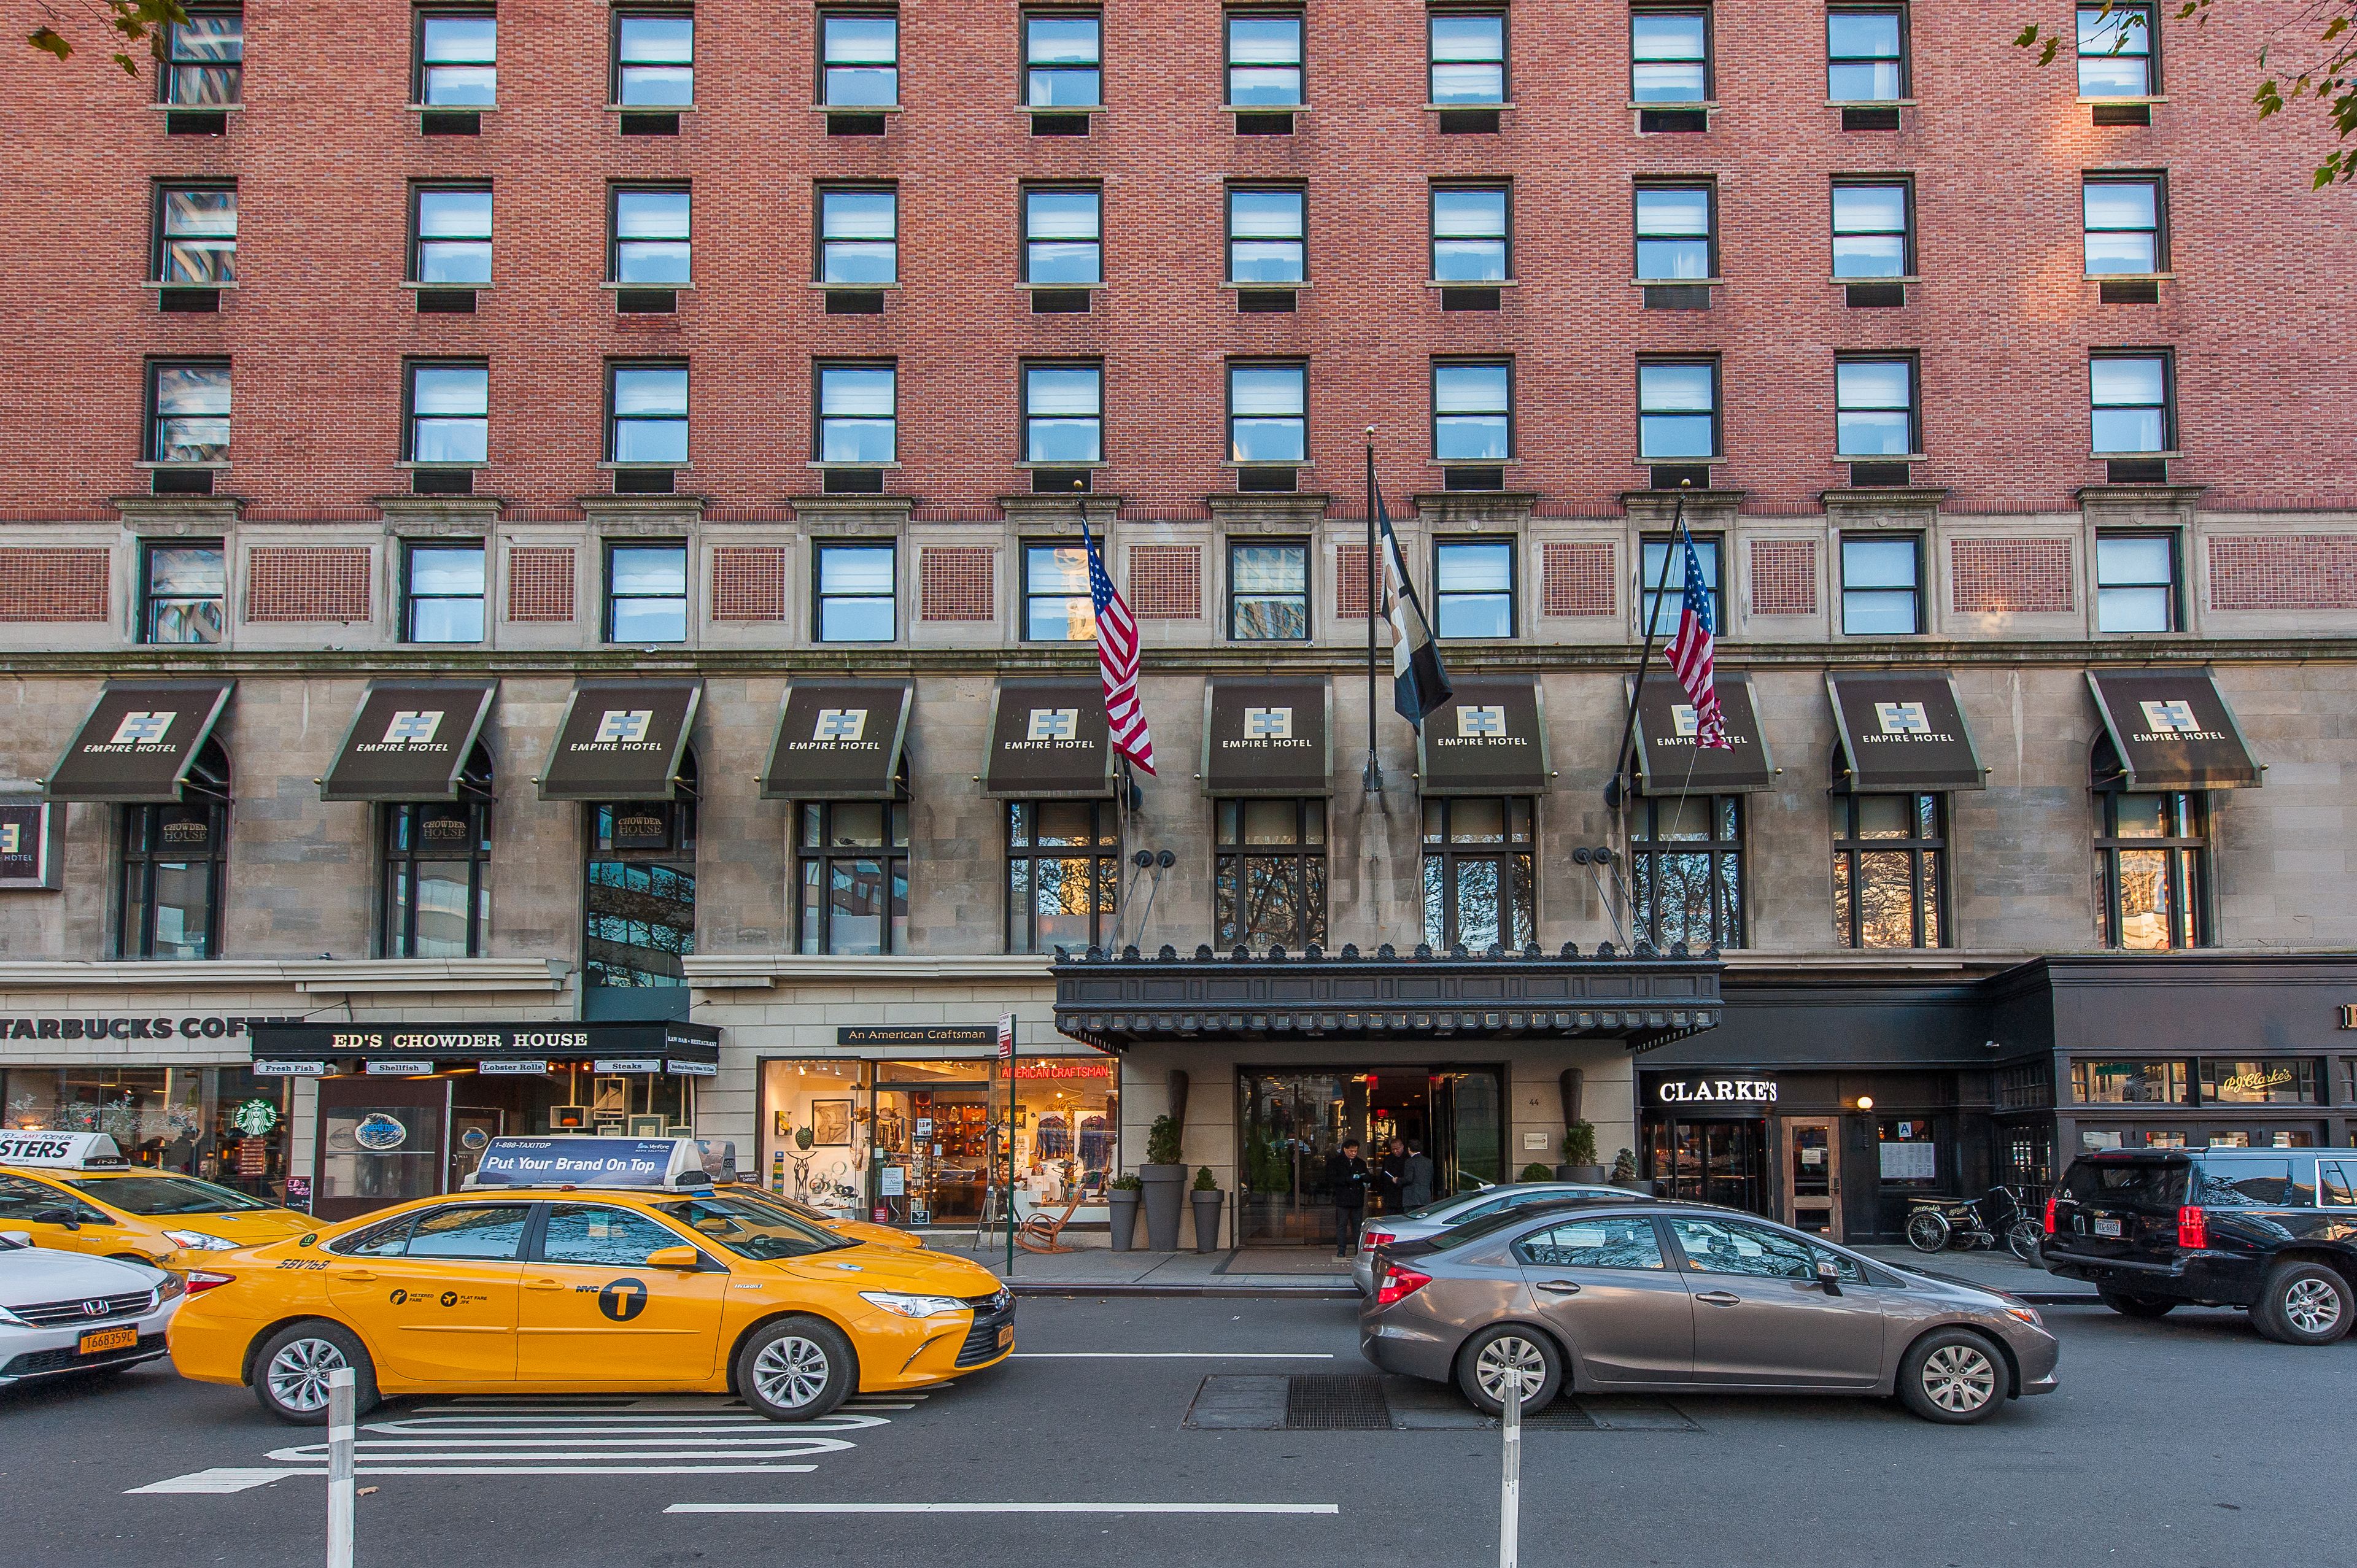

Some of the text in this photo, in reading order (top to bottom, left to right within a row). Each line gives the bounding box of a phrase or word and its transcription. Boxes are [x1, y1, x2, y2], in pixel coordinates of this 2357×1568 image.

[1914, 733, 1954, 742] HOTEL
[2184, 732, 2225, 741] HOTEL
[1055, 740, 1094, 749] HOTEL
[1273, 739, 1312, 747] HOTEL
[1438, 738, 1484, 746] EMPIRE
[135, 744, 177, 752] HOTEL
[408, 743, 448, 752] HOTEL
[164, 831, 207, 840] HOUSE
[927, 1030, 985, 1038] Craftsman
[332, 1033, 587, 1048] ED'S CHOWDER HOUSE
[1051, 1066, 1109, 1078] CRAFTSMAN
[1660, 1081, 1777, 1102] CLARKE'S
[1900, 1124, 1909, 1134] A
[486, 1157, 656, 1174] Put Your Brand On Top
[611, 1286, 638, 1316] T
[87, 1330, 133, 1348] T668359C
